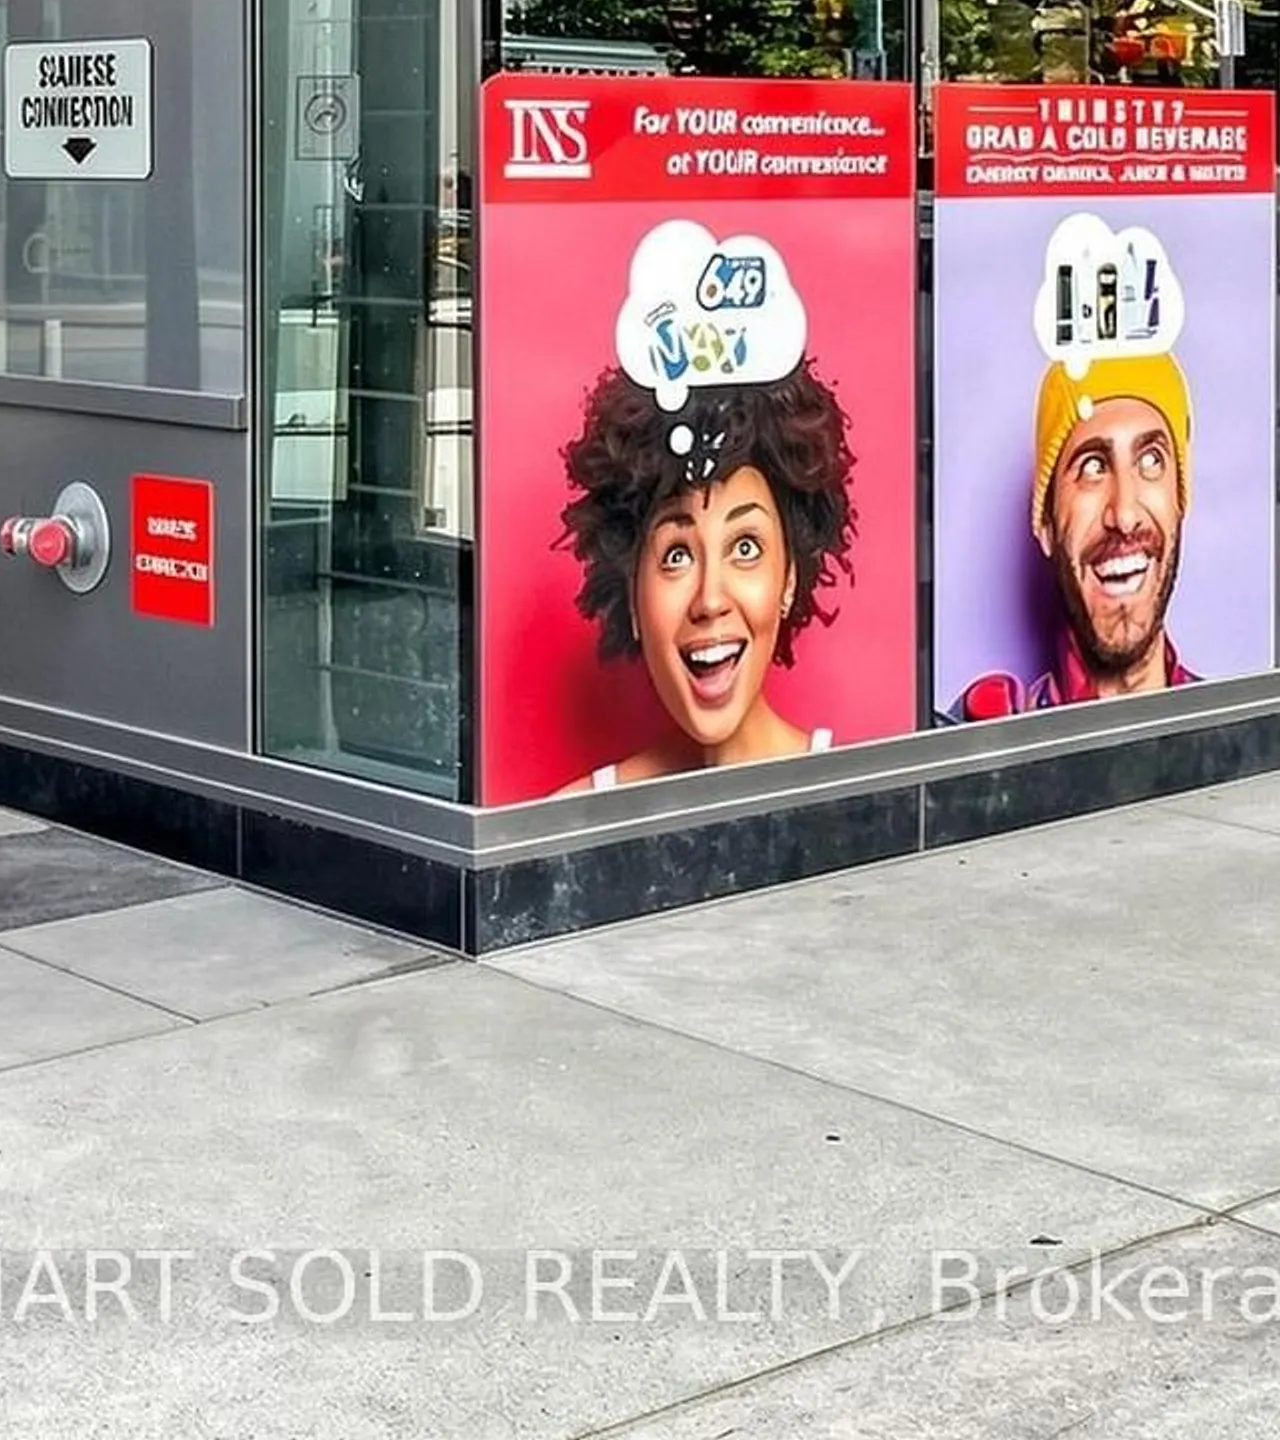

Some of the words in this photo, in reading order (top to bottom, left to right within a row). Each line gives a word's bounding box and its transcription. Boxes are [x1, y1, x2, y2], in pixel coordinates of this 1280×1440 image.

[634, 106, 670, 134] For
[675, 108, 737, 135] YOUR
[509, 107, 588, 166] INS
[1039, 125, 1059, 151] A
[1066, 126, 1127, 151] COLD
[694, 148, 759, 175] YOUR
